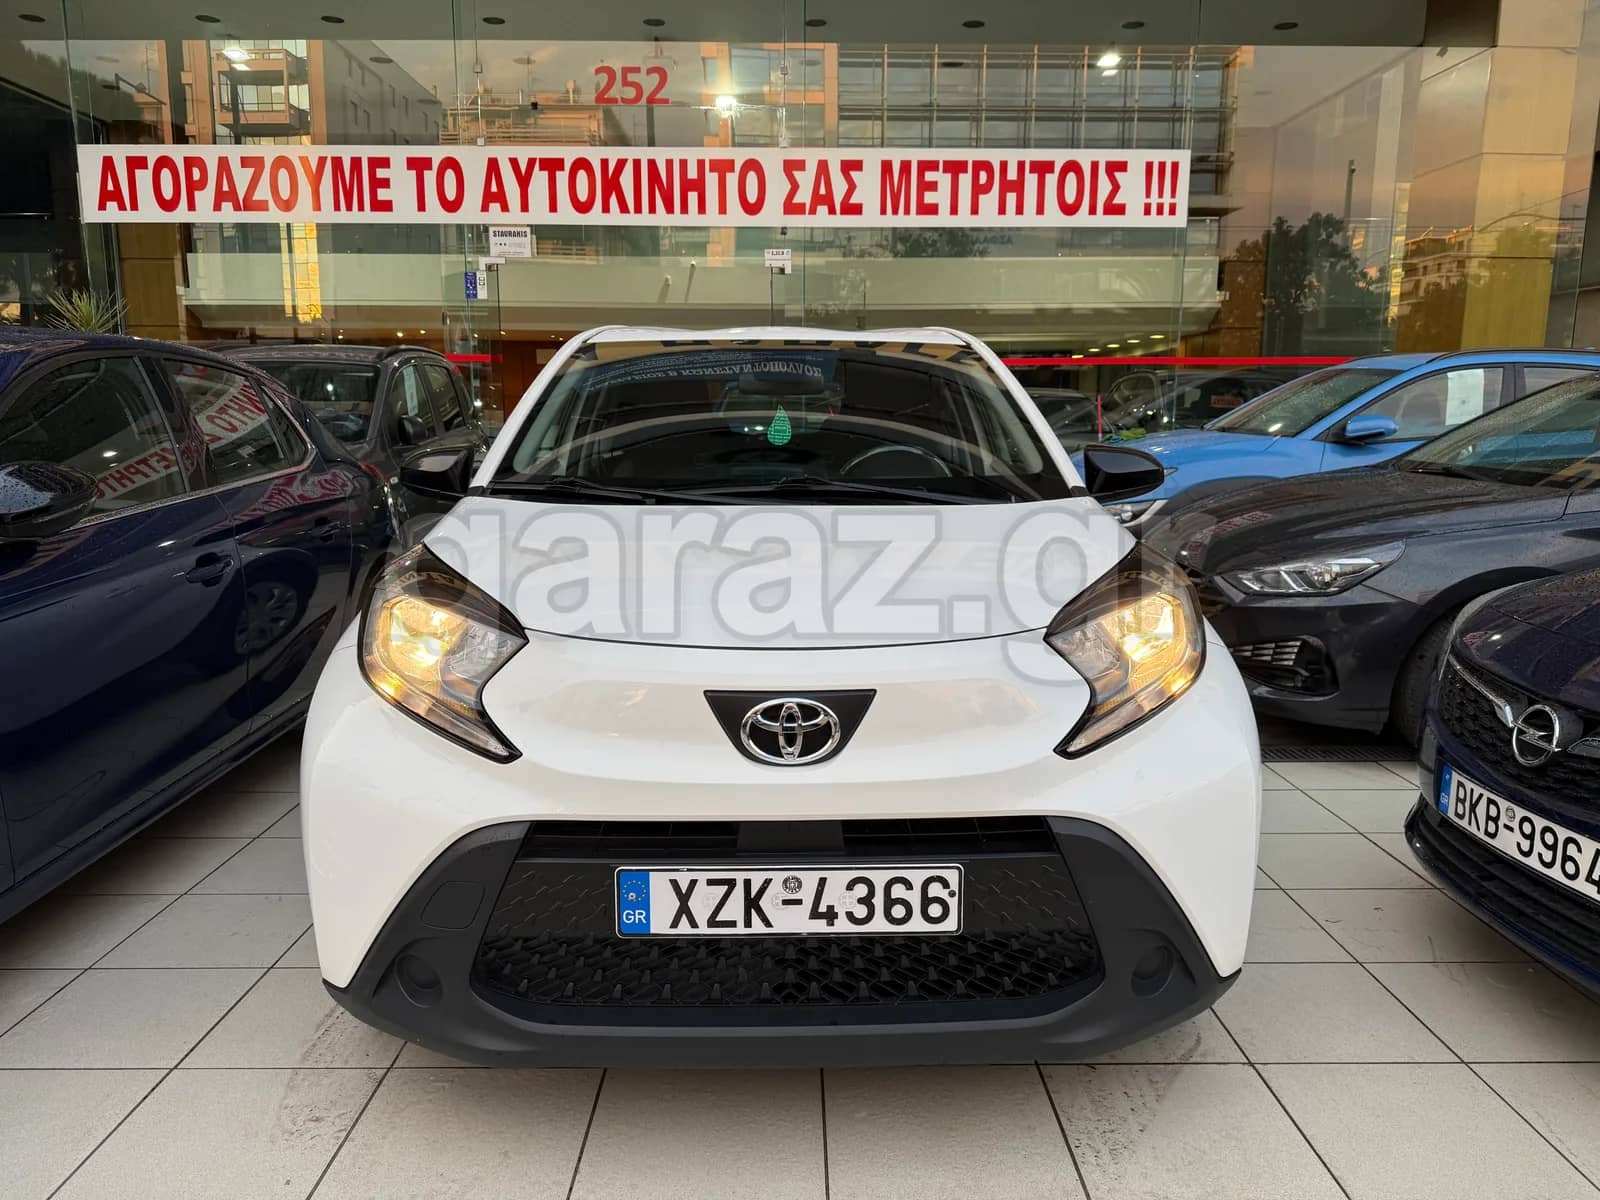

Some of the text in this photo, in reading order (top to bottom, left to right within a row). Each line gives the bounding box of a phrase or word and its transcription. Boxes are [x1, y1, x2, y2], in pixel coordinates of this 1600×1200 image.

[594, 65, 670, 105] 252
[98, 155, 1179, 217] ΑΓΟΡΑΖΟΥΜΕ ΤΟ ΑΥΤΟΚΙΝΗΤΟ ΣΑΣ ΜΕΤΡΗΤΟΙΣ !!!
[622, 909, 648, 925] GR
[668, 875, 951, 930] XZK-4366
